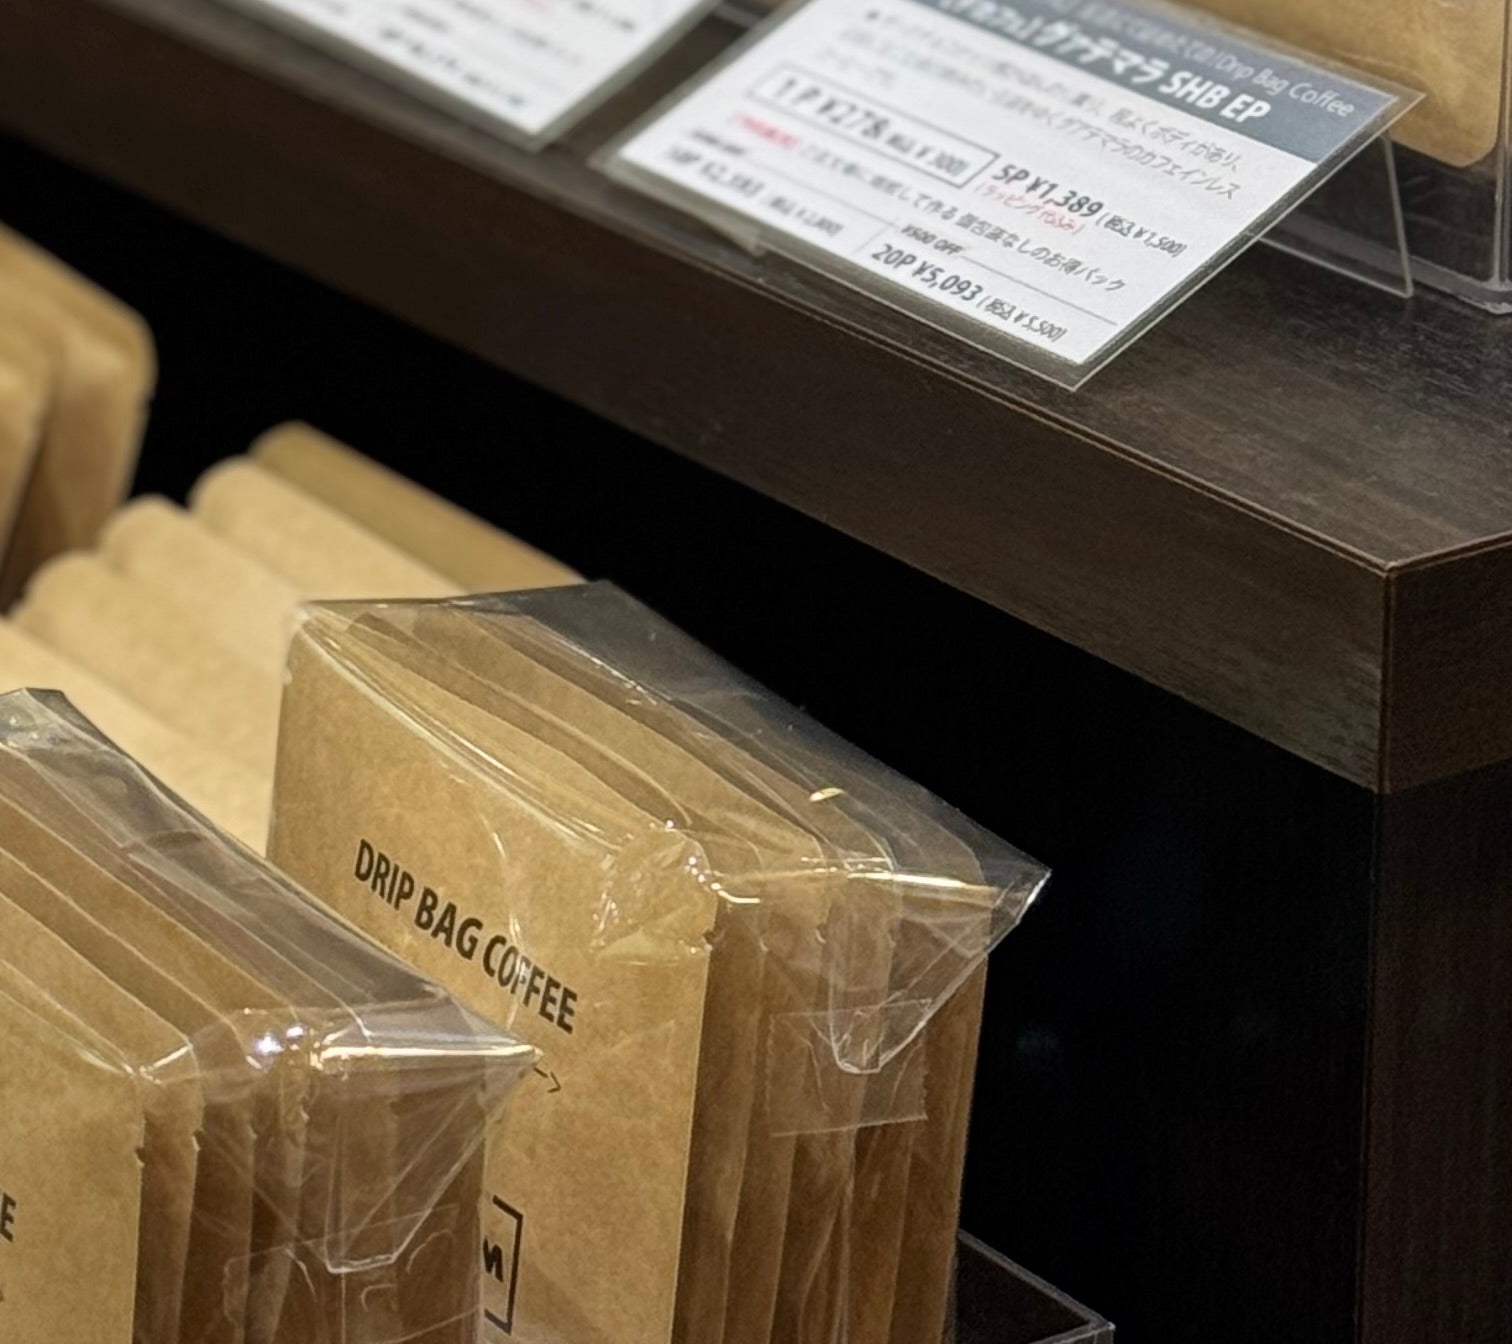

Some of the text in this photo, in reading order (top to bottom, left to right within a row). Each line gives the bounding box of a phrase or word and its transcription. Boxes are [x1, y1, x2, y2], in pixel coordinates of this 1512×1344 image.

[1158, 70, 1231, 110] SHB
[1219, 94, 1272, 124] EP
[1253, 68, 1290, 97] Bag
[1288, 82, 1356, 118] Coffee
[991, 164, 1030, 184] 5P
[1025, 178, 1105, 218] ¥1,389
[872, 243, 916, 270] 20P
[912, 260, 984, 303] ¥5,093
[935, 236, 966, 257] OFF
[354, 838, 580, 1035] DRIP BAG COFFEE
